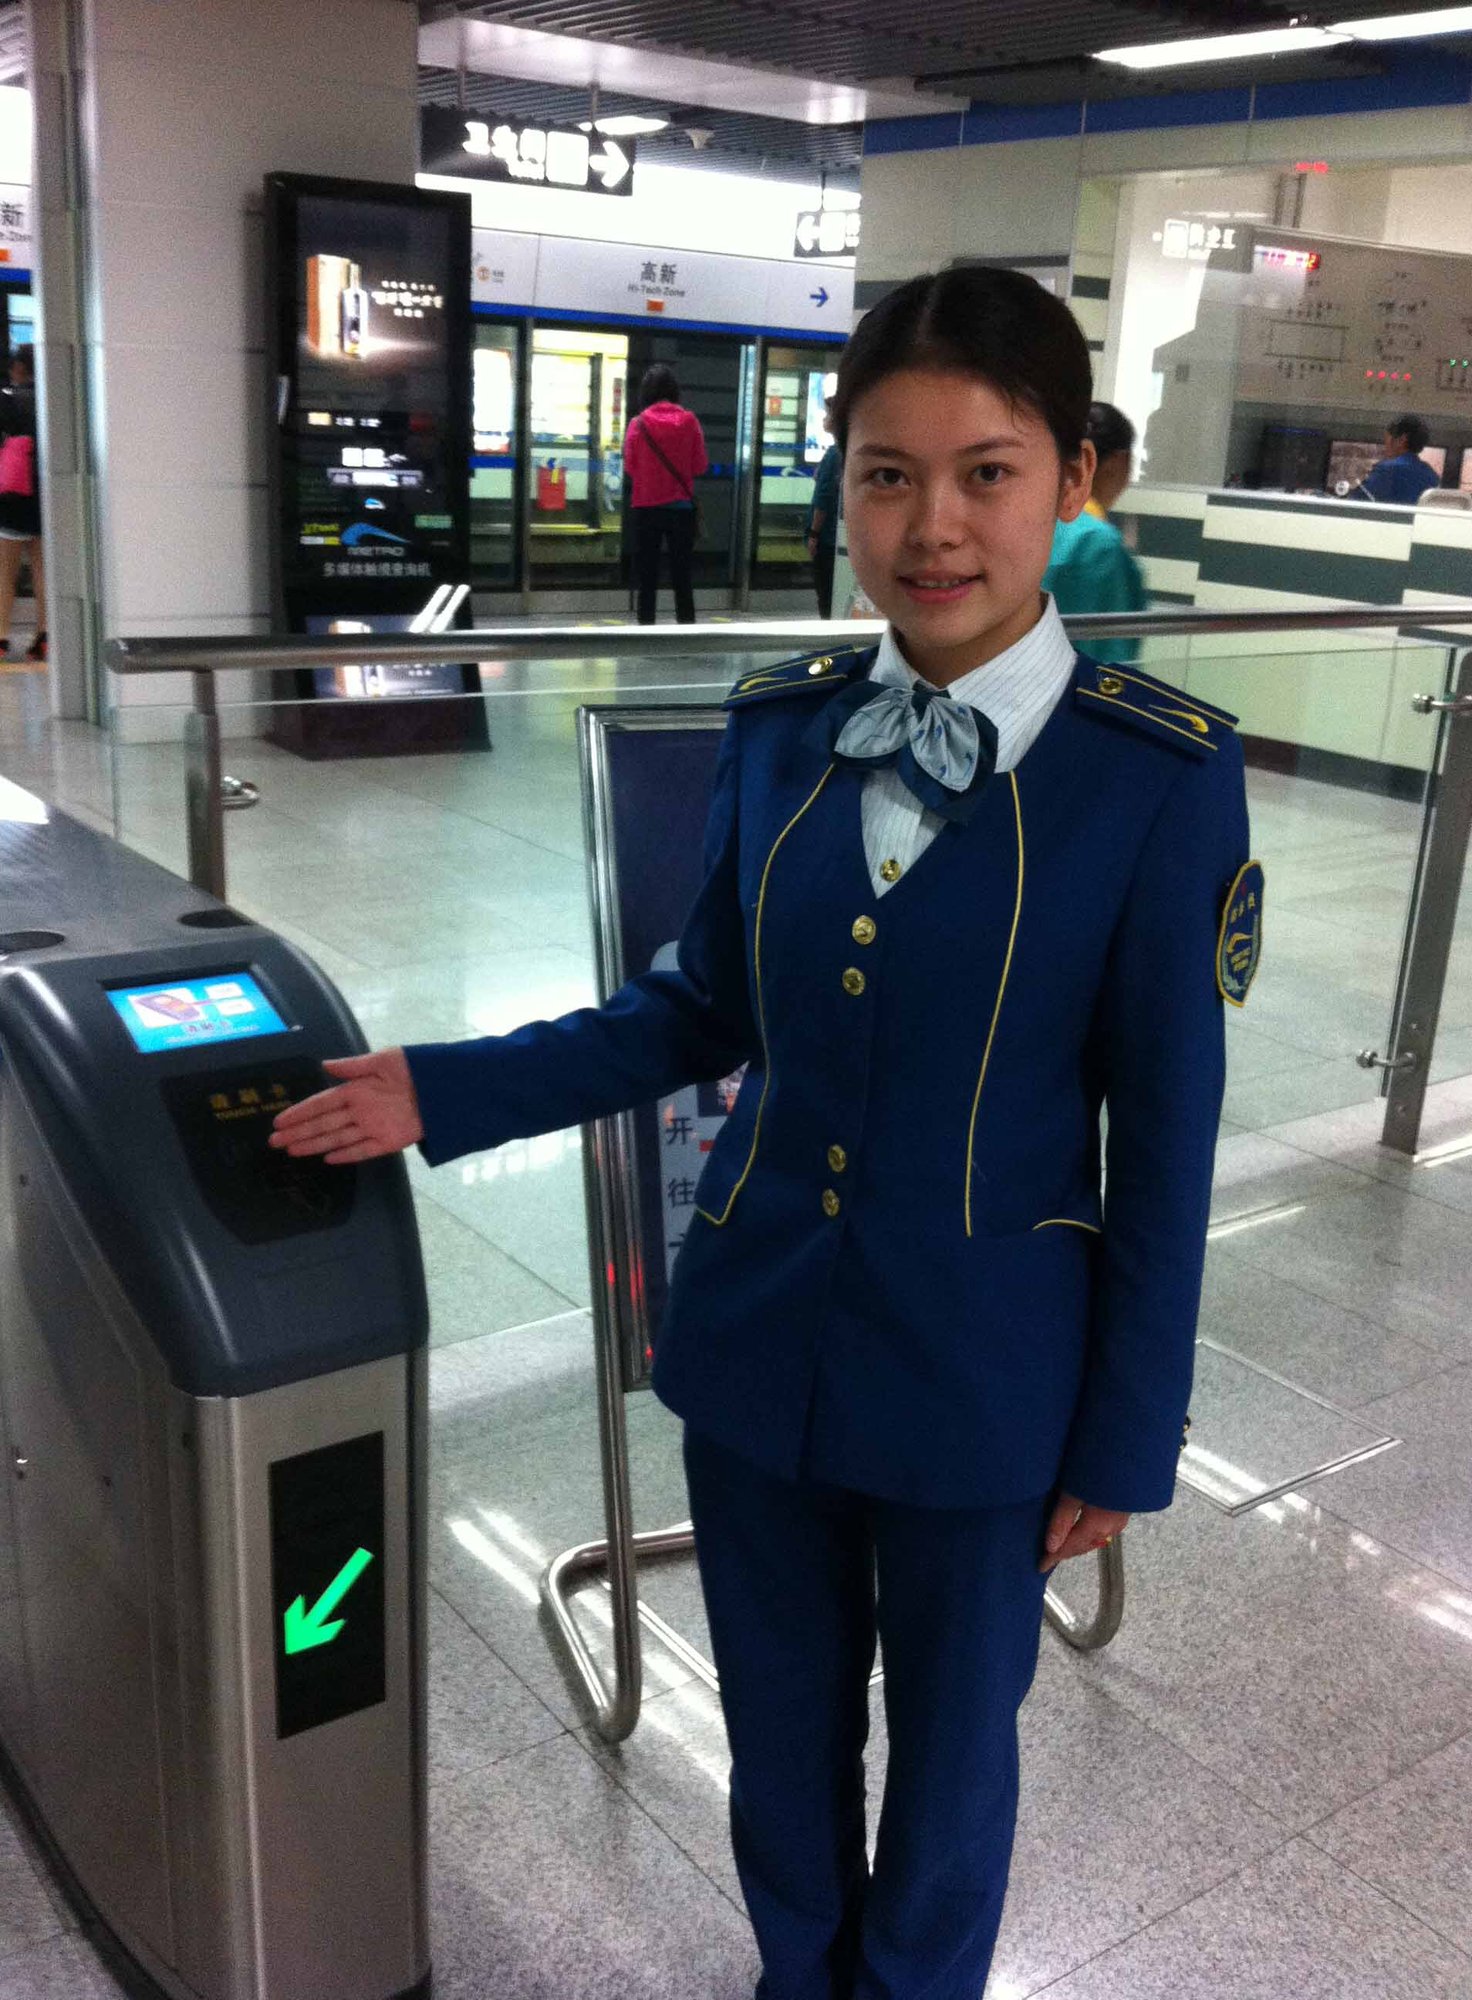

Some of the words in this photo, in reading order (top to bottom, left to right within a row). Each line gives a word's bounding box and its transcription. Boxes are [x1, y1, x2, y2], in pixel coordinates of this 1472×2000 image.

[640, 261, 677, 285] 高新
[627, 284, 662, 295] Hi-Tech
[663, 287, 685, 297] Zone
